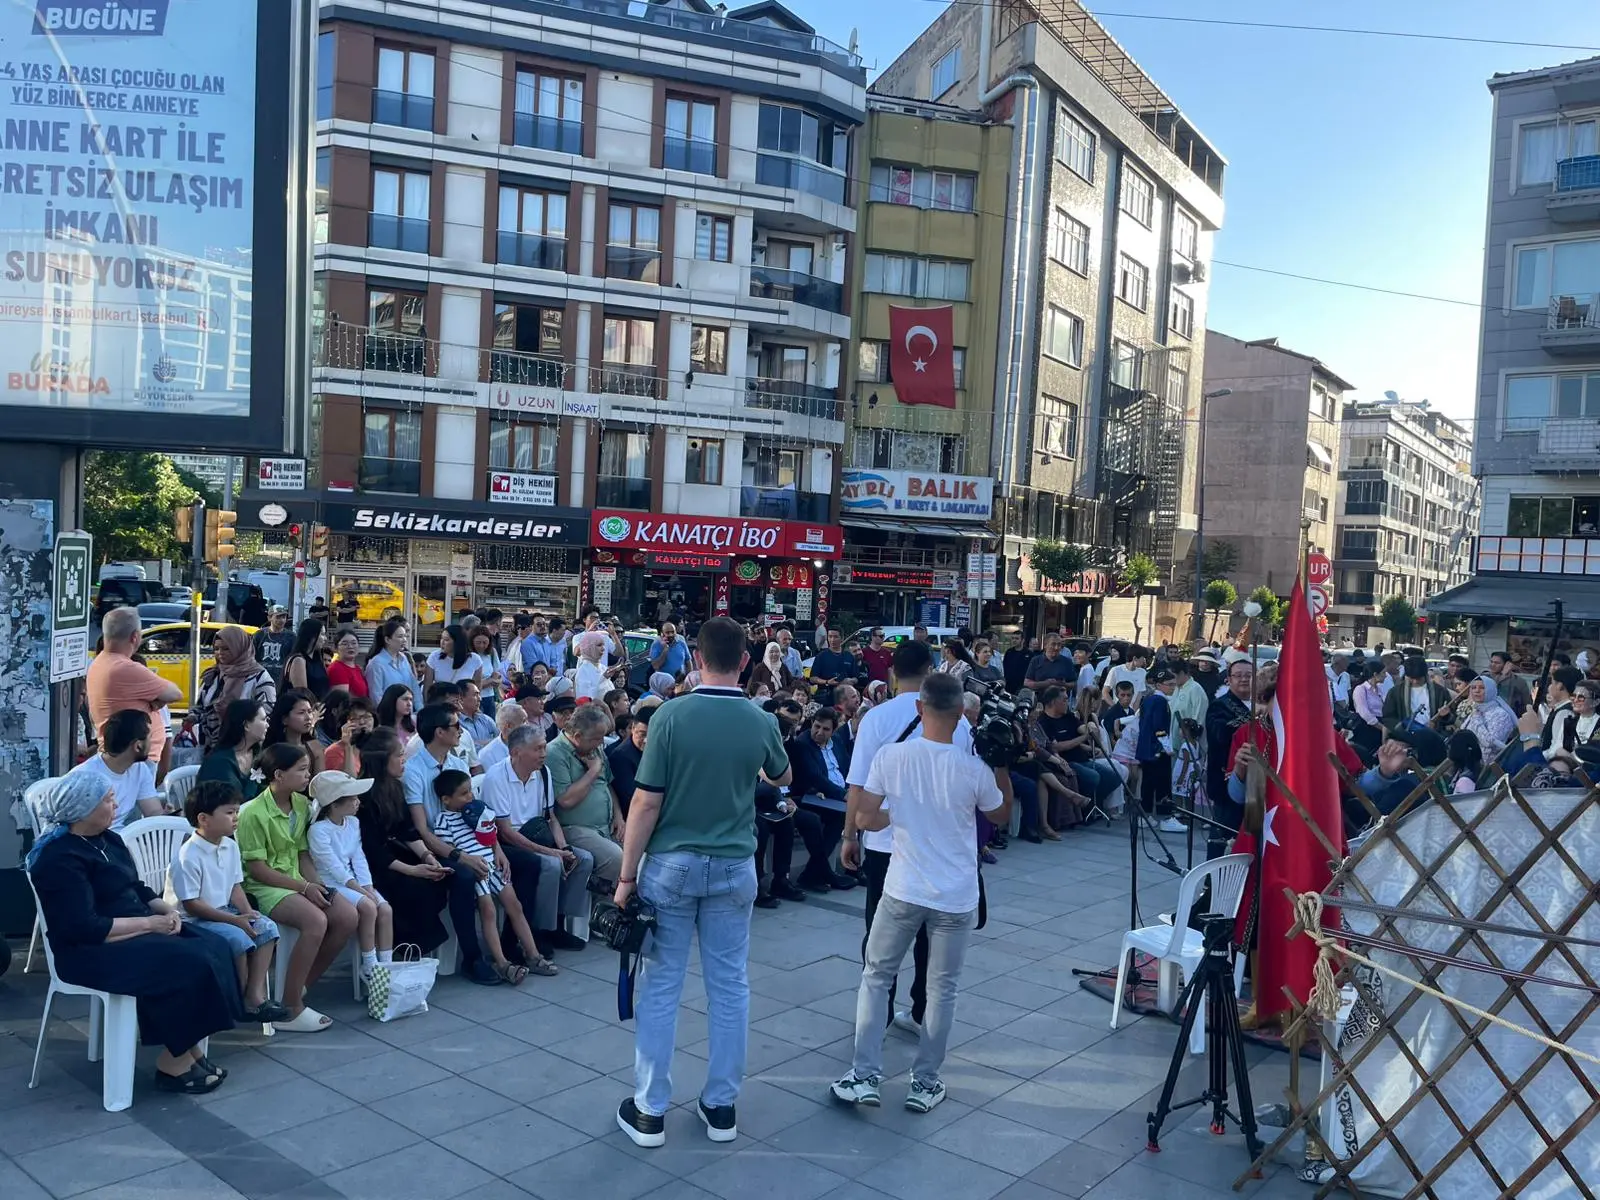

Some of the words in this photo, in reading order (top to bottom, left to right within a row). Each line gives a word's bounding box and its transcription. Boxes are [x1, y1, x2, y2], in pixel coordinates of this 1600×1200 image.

[46, 2, 157, 31] BUGÜNE
[21, 62, 52, 84] YAŞ
[58, 64, 107, 84] ARASI
[111, 67, 176, 89] ÇOCUĞU
[180, 73, 225, 94] OLAN
[12, 83, 43, 104] YÜZ
[48, 85, 127, 110] BİNLERCE
[132, 93, 199, 115] ANNEYE
[0, 118, 70, 152] NNE
[80, 123, 167, 159] KART
[178, 121, 226, 164] İLE
[0, 160, 114, 198] RETSİZ
[125, 169, 243, 213] ULAŞIM
[44, 201, 158, 246] İMKANI
[5, 250, 196, 292] SUNUYORUZ
[8, 372, 110, 394] BURADA
[518, 396, 554, 409] UZUN
[565, 401, 598, 414] İNŞAAT
[513, 476, 525, 488] DİŞ
[528, 477, 554, 489] HEKİMİ
[907, 477, 979, 500] BALIK
[354, 509, 562, 539] Sekizkardeşler
[634, 521, 735, 550] KANATÇI
[739, 521, 777, 549] İBO
[1310, 563, 1329, 575] UR
